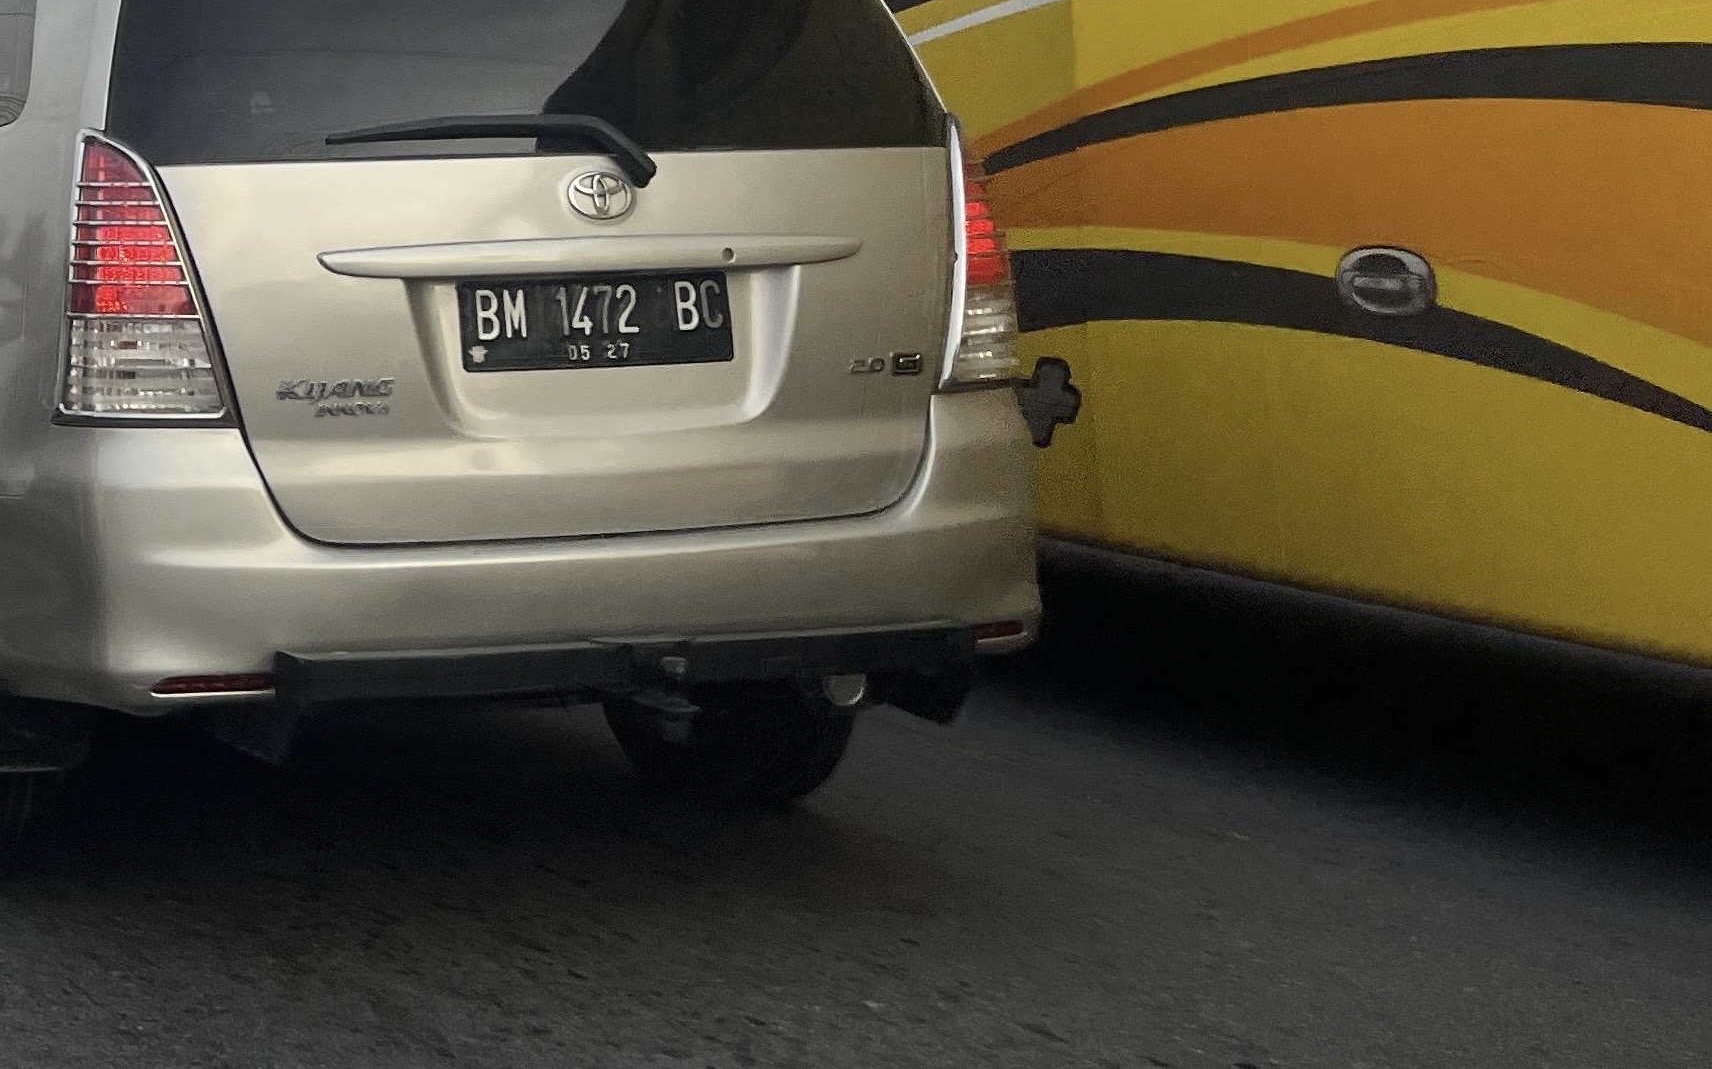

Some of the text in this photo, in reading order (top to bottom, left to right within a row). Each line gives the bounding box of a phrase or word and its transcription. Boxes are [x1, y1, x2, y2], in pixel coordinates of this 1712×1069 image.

[475, 280, 724, 341] BM 1472 BC
[567, 341, 630, 361] 05 27
